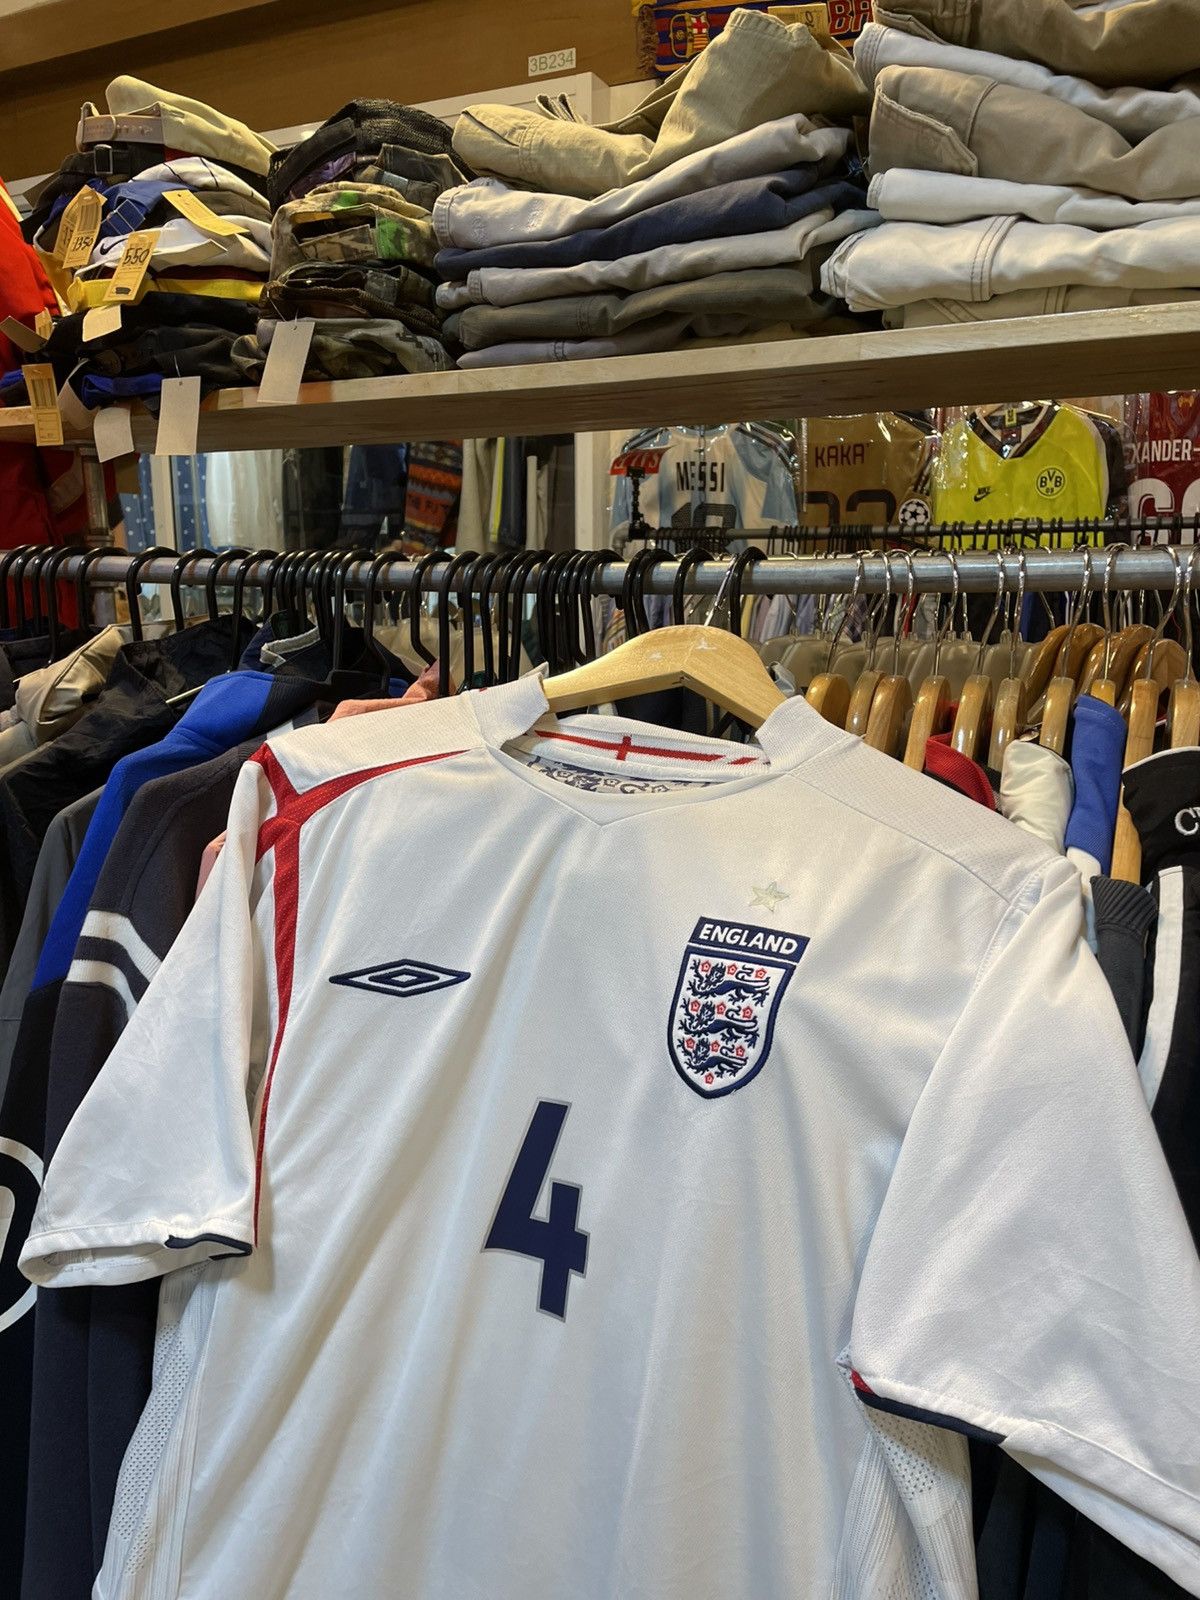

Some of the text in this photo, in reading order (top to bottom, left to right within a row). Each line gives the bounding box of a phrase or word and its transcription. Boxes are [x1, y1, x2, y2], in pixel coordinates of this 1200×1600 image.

[530, 51, 574, 72] 3B234
[124, 248, 150, 266] 550
[676, 461, 725, 492] MESSI
[1040, 469, 1062, 488] BVB
[699, 923, 798, 955] ENGLAND
[480, 1098, 590, 1322] 4
